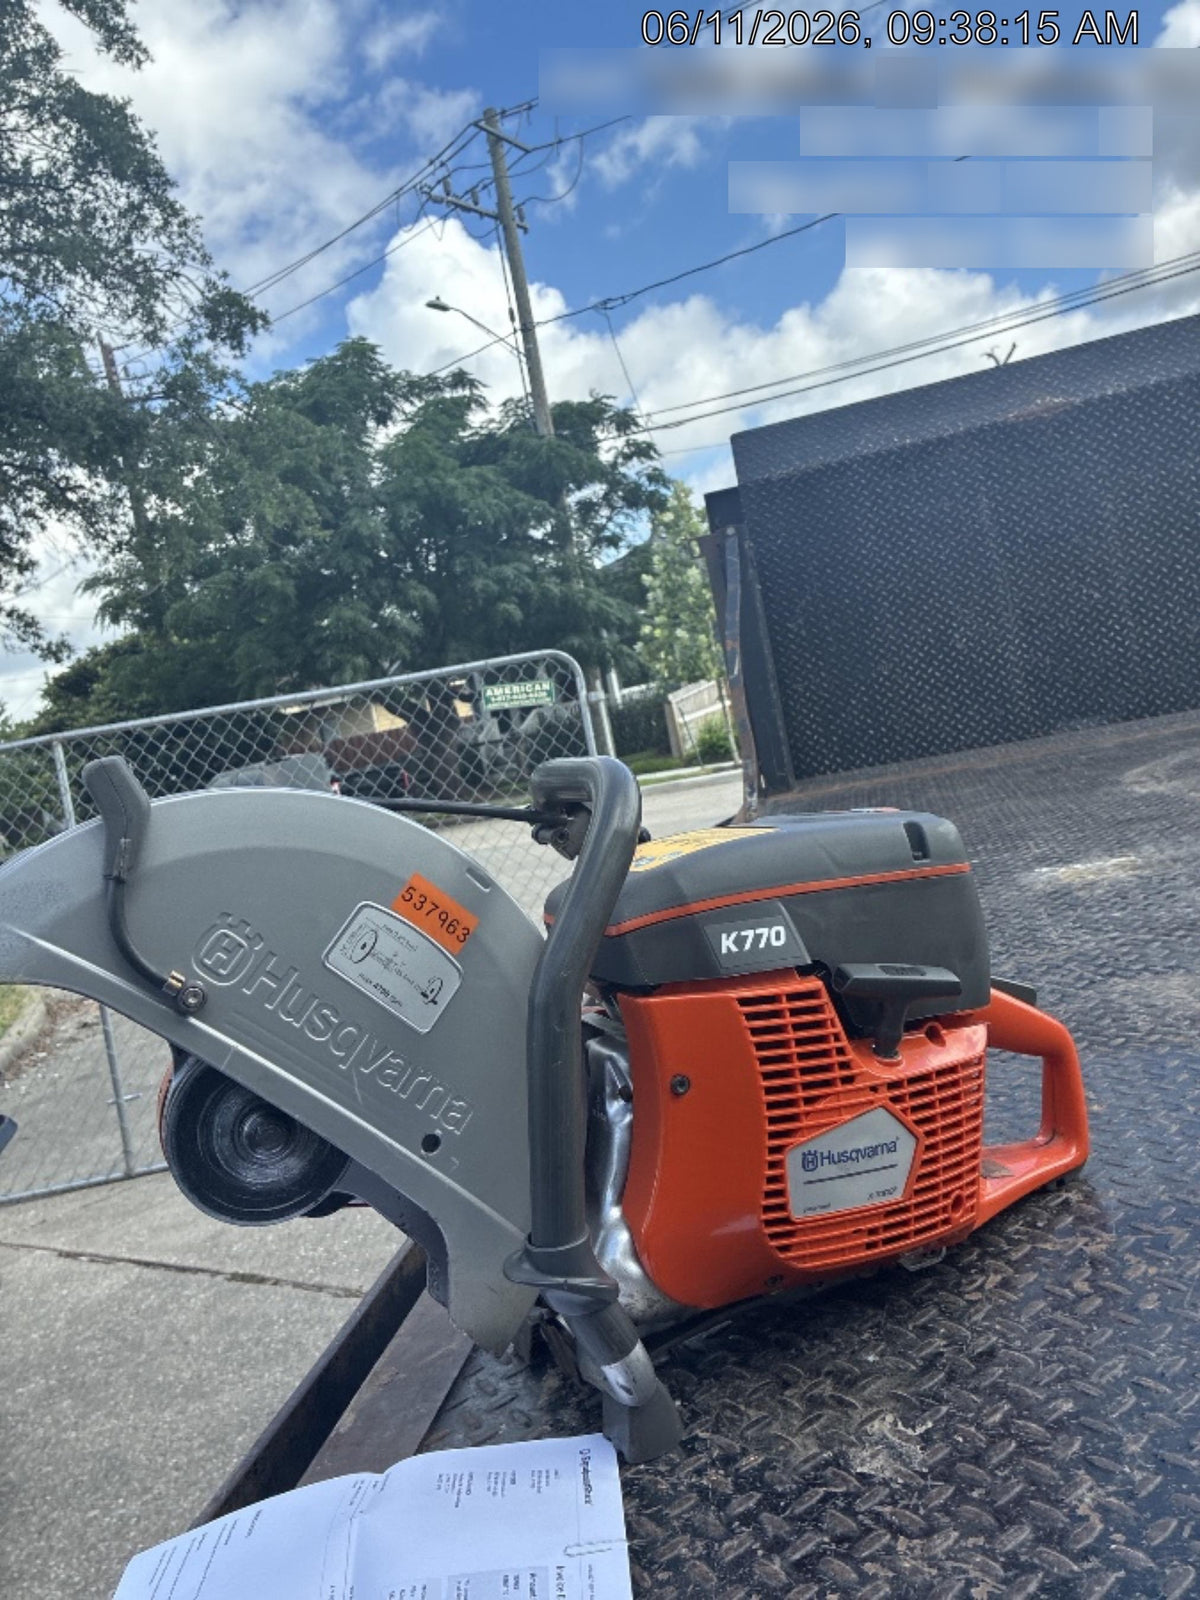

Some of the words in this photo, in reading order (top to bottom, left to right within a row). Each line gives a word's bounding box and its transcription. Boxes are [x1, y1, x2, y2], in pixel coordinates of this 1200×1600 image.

[486, 681, 550, 696] AMERICAN
[401, 886, 470, 943] 537963
[721, 926, 787, 954] K770
[242, 950, 474, 1135] Husqvarna
[820, 1140, 897, 1167] Husqvarna
